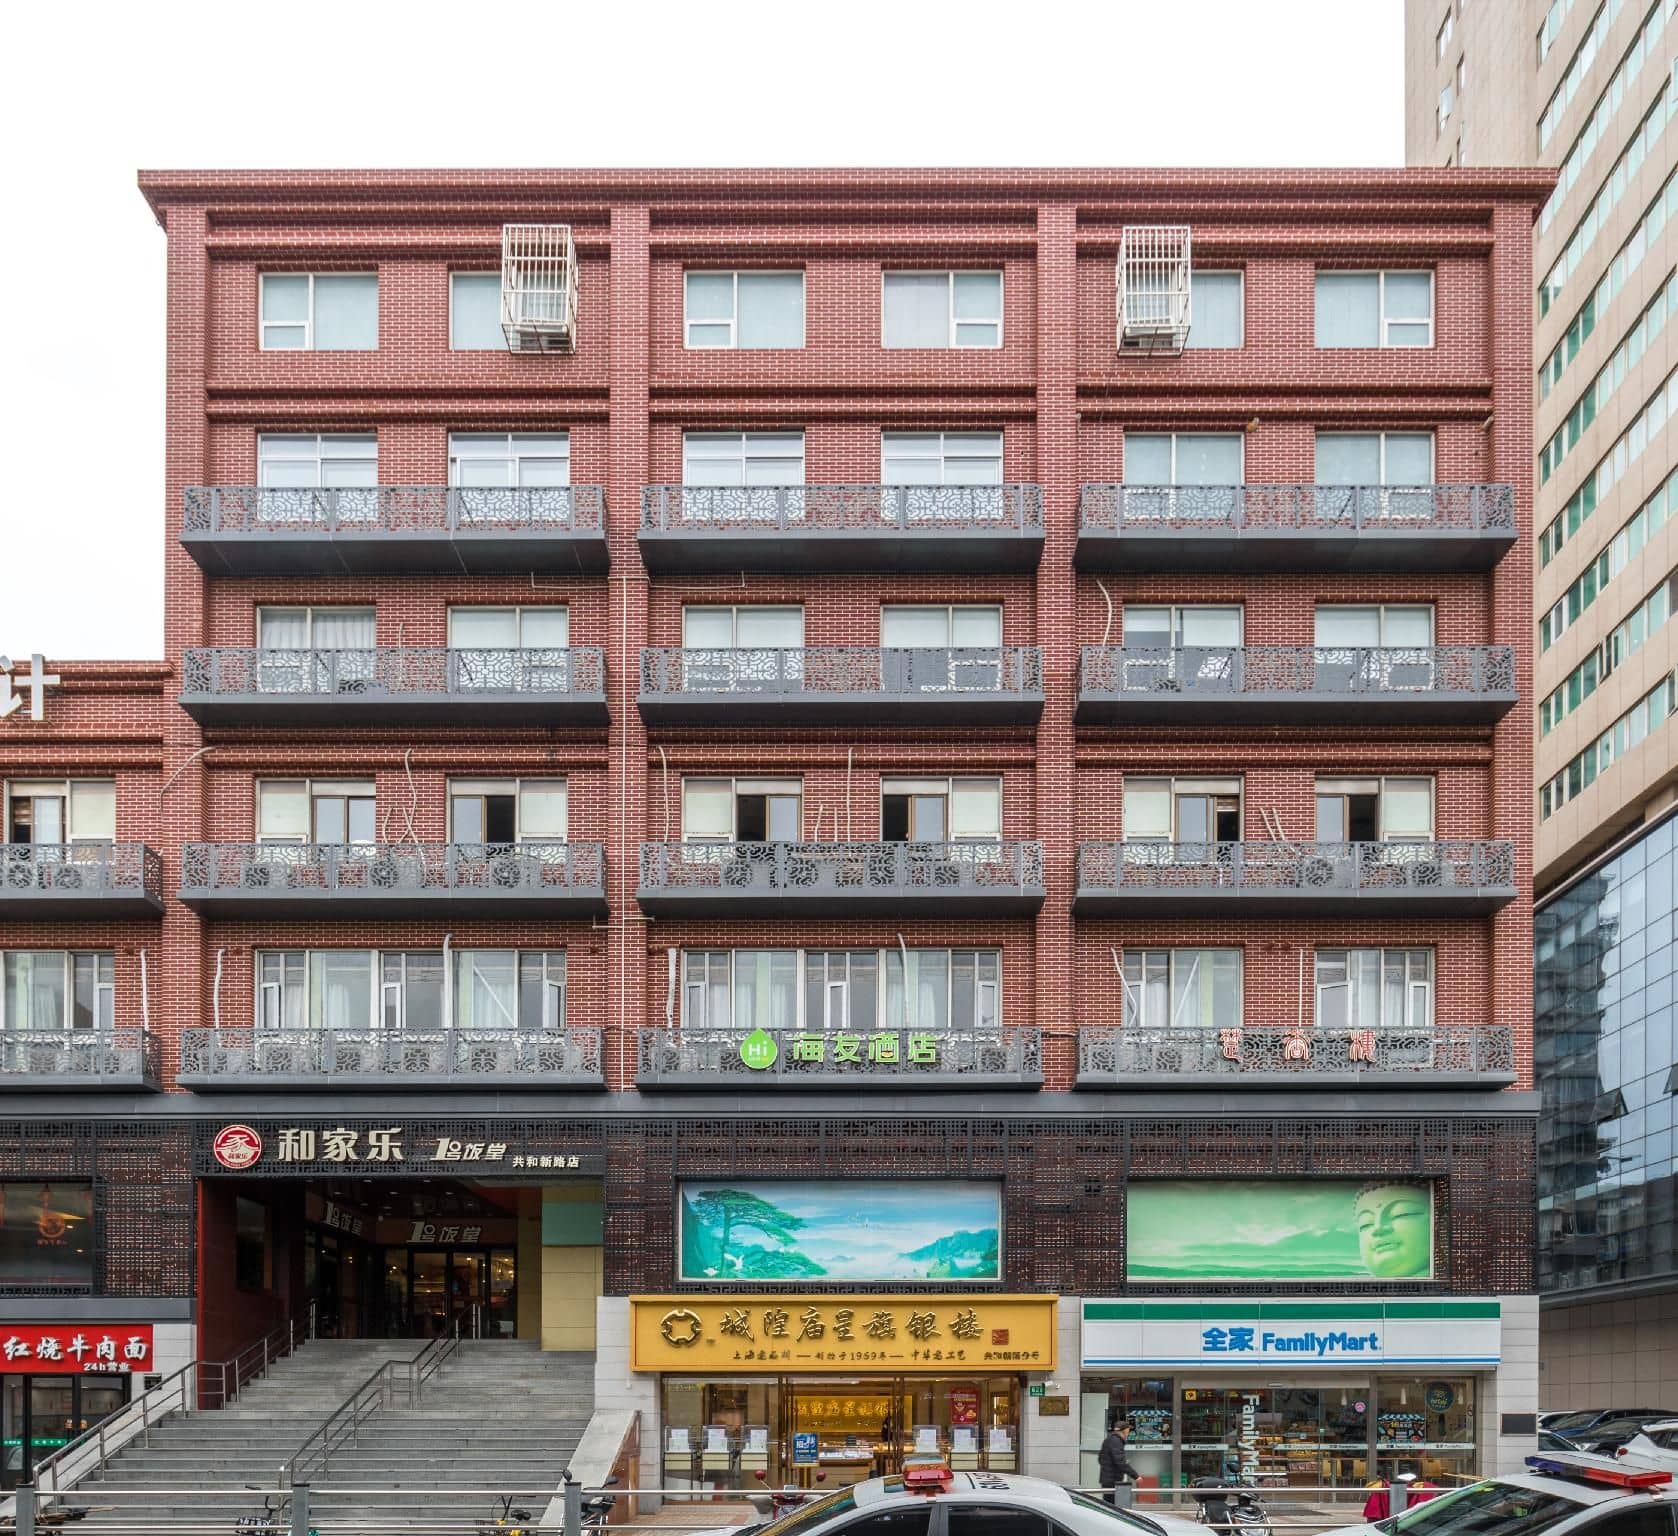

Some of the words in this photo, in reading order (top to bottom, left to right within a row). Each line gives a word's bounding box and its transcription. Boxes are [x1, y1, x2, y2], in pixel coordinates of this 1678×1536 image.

[793, 1032, 937, 1063] 海友酒店
[278, 1127, 405, 1162] 和家乐
[512, 1155, 580, 1168] 共和新路店
[3, 1333, 149, 1363] 红烧牛肉面
[1202, 1327, 1255, 1352] 全家
[1262, 1332, 1379, 1357] FamilyMart
